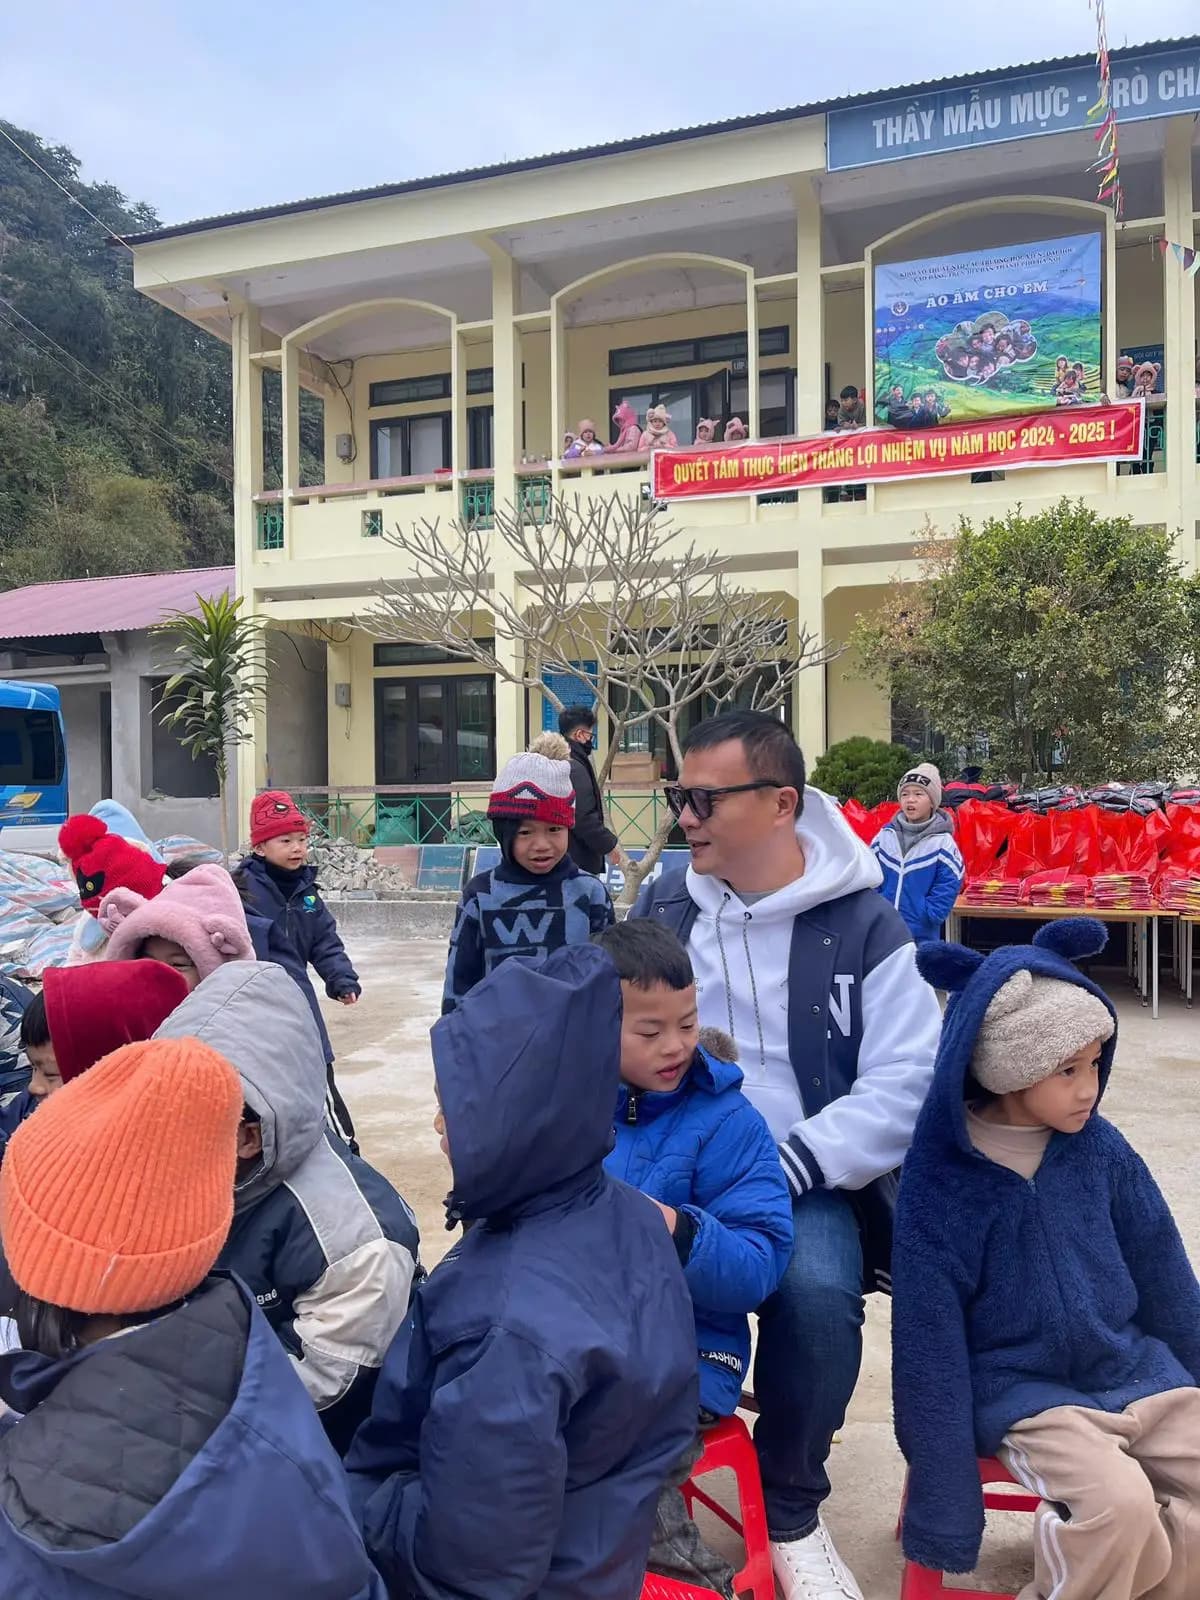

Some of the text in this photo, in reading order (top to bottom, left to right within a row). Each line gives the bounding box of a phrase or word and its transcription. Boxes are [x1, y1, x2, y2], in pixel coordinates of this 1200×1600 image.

[872, 101, 936, 148] THẦY
[943, 88, 1001, 137] MẪU
[1010, 85, 1070, 127] MỰC
[983, 284, 1018, 299] CHO
[1022, 280, 1049, 294] EM
[673, 456, 709, 485] QUYẾT
[713, 456, 739, 480] TÂM
[743, 454, 774, 480] THỰC
[778, 451, 808, 477] HIỆN
[812, 442, 854, 470] THẮNG
[857, 443, 877, 469] LỢI
[881, 436, 925, 466] NHIỆM
[929, 440, 948, 463] VỤ
[951, 430, 984, 457] NĂM
[988, 431, 1016, 457] HỌC
[1020, 424, 1056, 448] 2024
[1069, 421, 1106, 443] 2025
